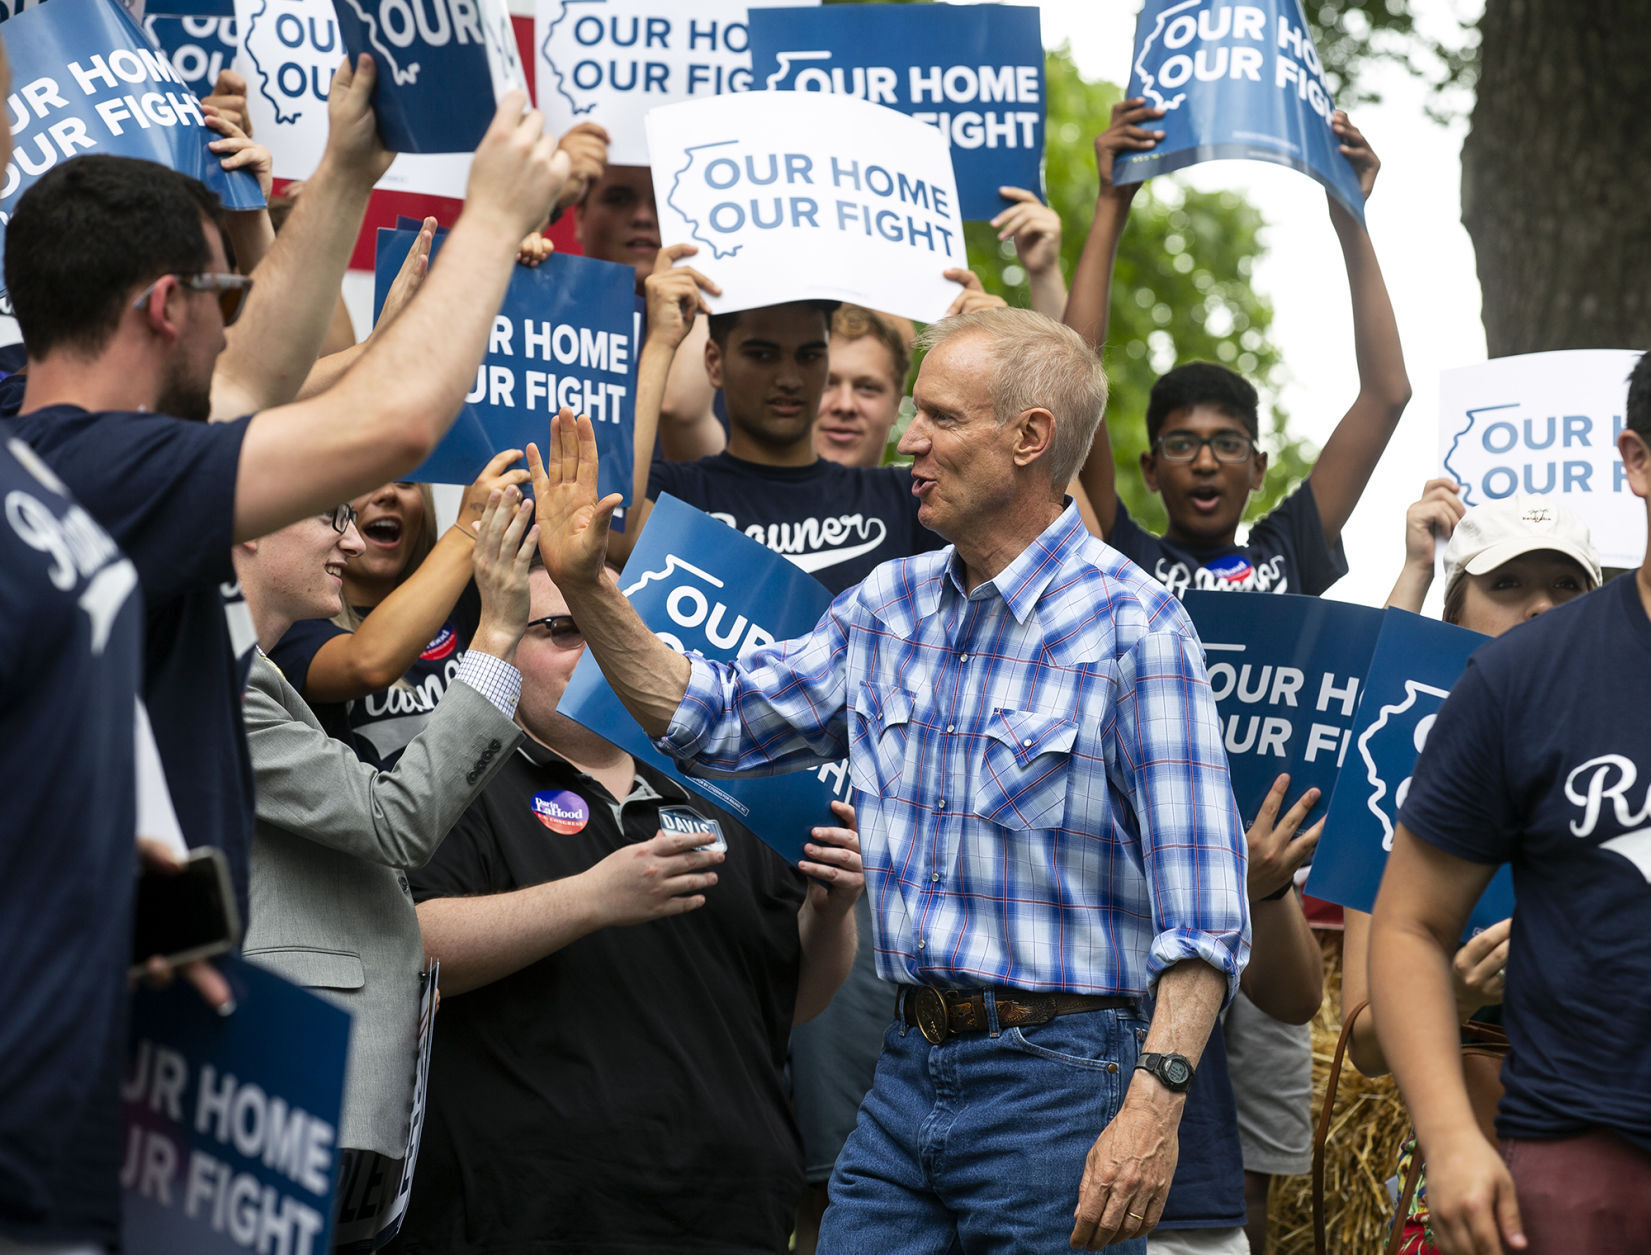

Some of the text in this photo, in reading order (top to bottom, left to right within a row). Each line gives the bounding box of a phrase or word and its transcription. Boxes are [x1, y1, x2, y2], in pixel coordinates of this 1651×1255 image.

[276, 13, 348, 54] OU
[574, 16, 749, 53] OUR HO
[1163, 6, 1328, 88] OUR HO
[6, 48, 187, 136] UR HOM
[278, 62, 336, 101] OU
[572, 60, 753, 96] OUR FIG
[794, 65, 1039, 103] OUR HOME
[1158, 47, 1335, 127] OUR FIG
[95, 92, 205, 136] FIGH
[704, 154, 951, 220] OUR HOME
[709, 197, 954, 257] OUR FIGHT
[524, 319, 629, 374] HOME
[464, 365, 627, 424] UR FIGHT
[1482, 415, 1593, 454] OUR
[1482, 460, 1593, 500] OUR
[1206, 662, 1304, 707] OUR
[1218, 713, 1293, 758] UR
[535, 797, 559, 809] Darin
[535, 803, 583, 819] LaHood
[661, 813, 710, 834] DAVIS
[122, 1042, 187, 1122] UR
[194, 1062, 336, 1197] HOME
[119, 1124, 177, 1205] UR
[184, 1150, 324, 1255] FIGHT
